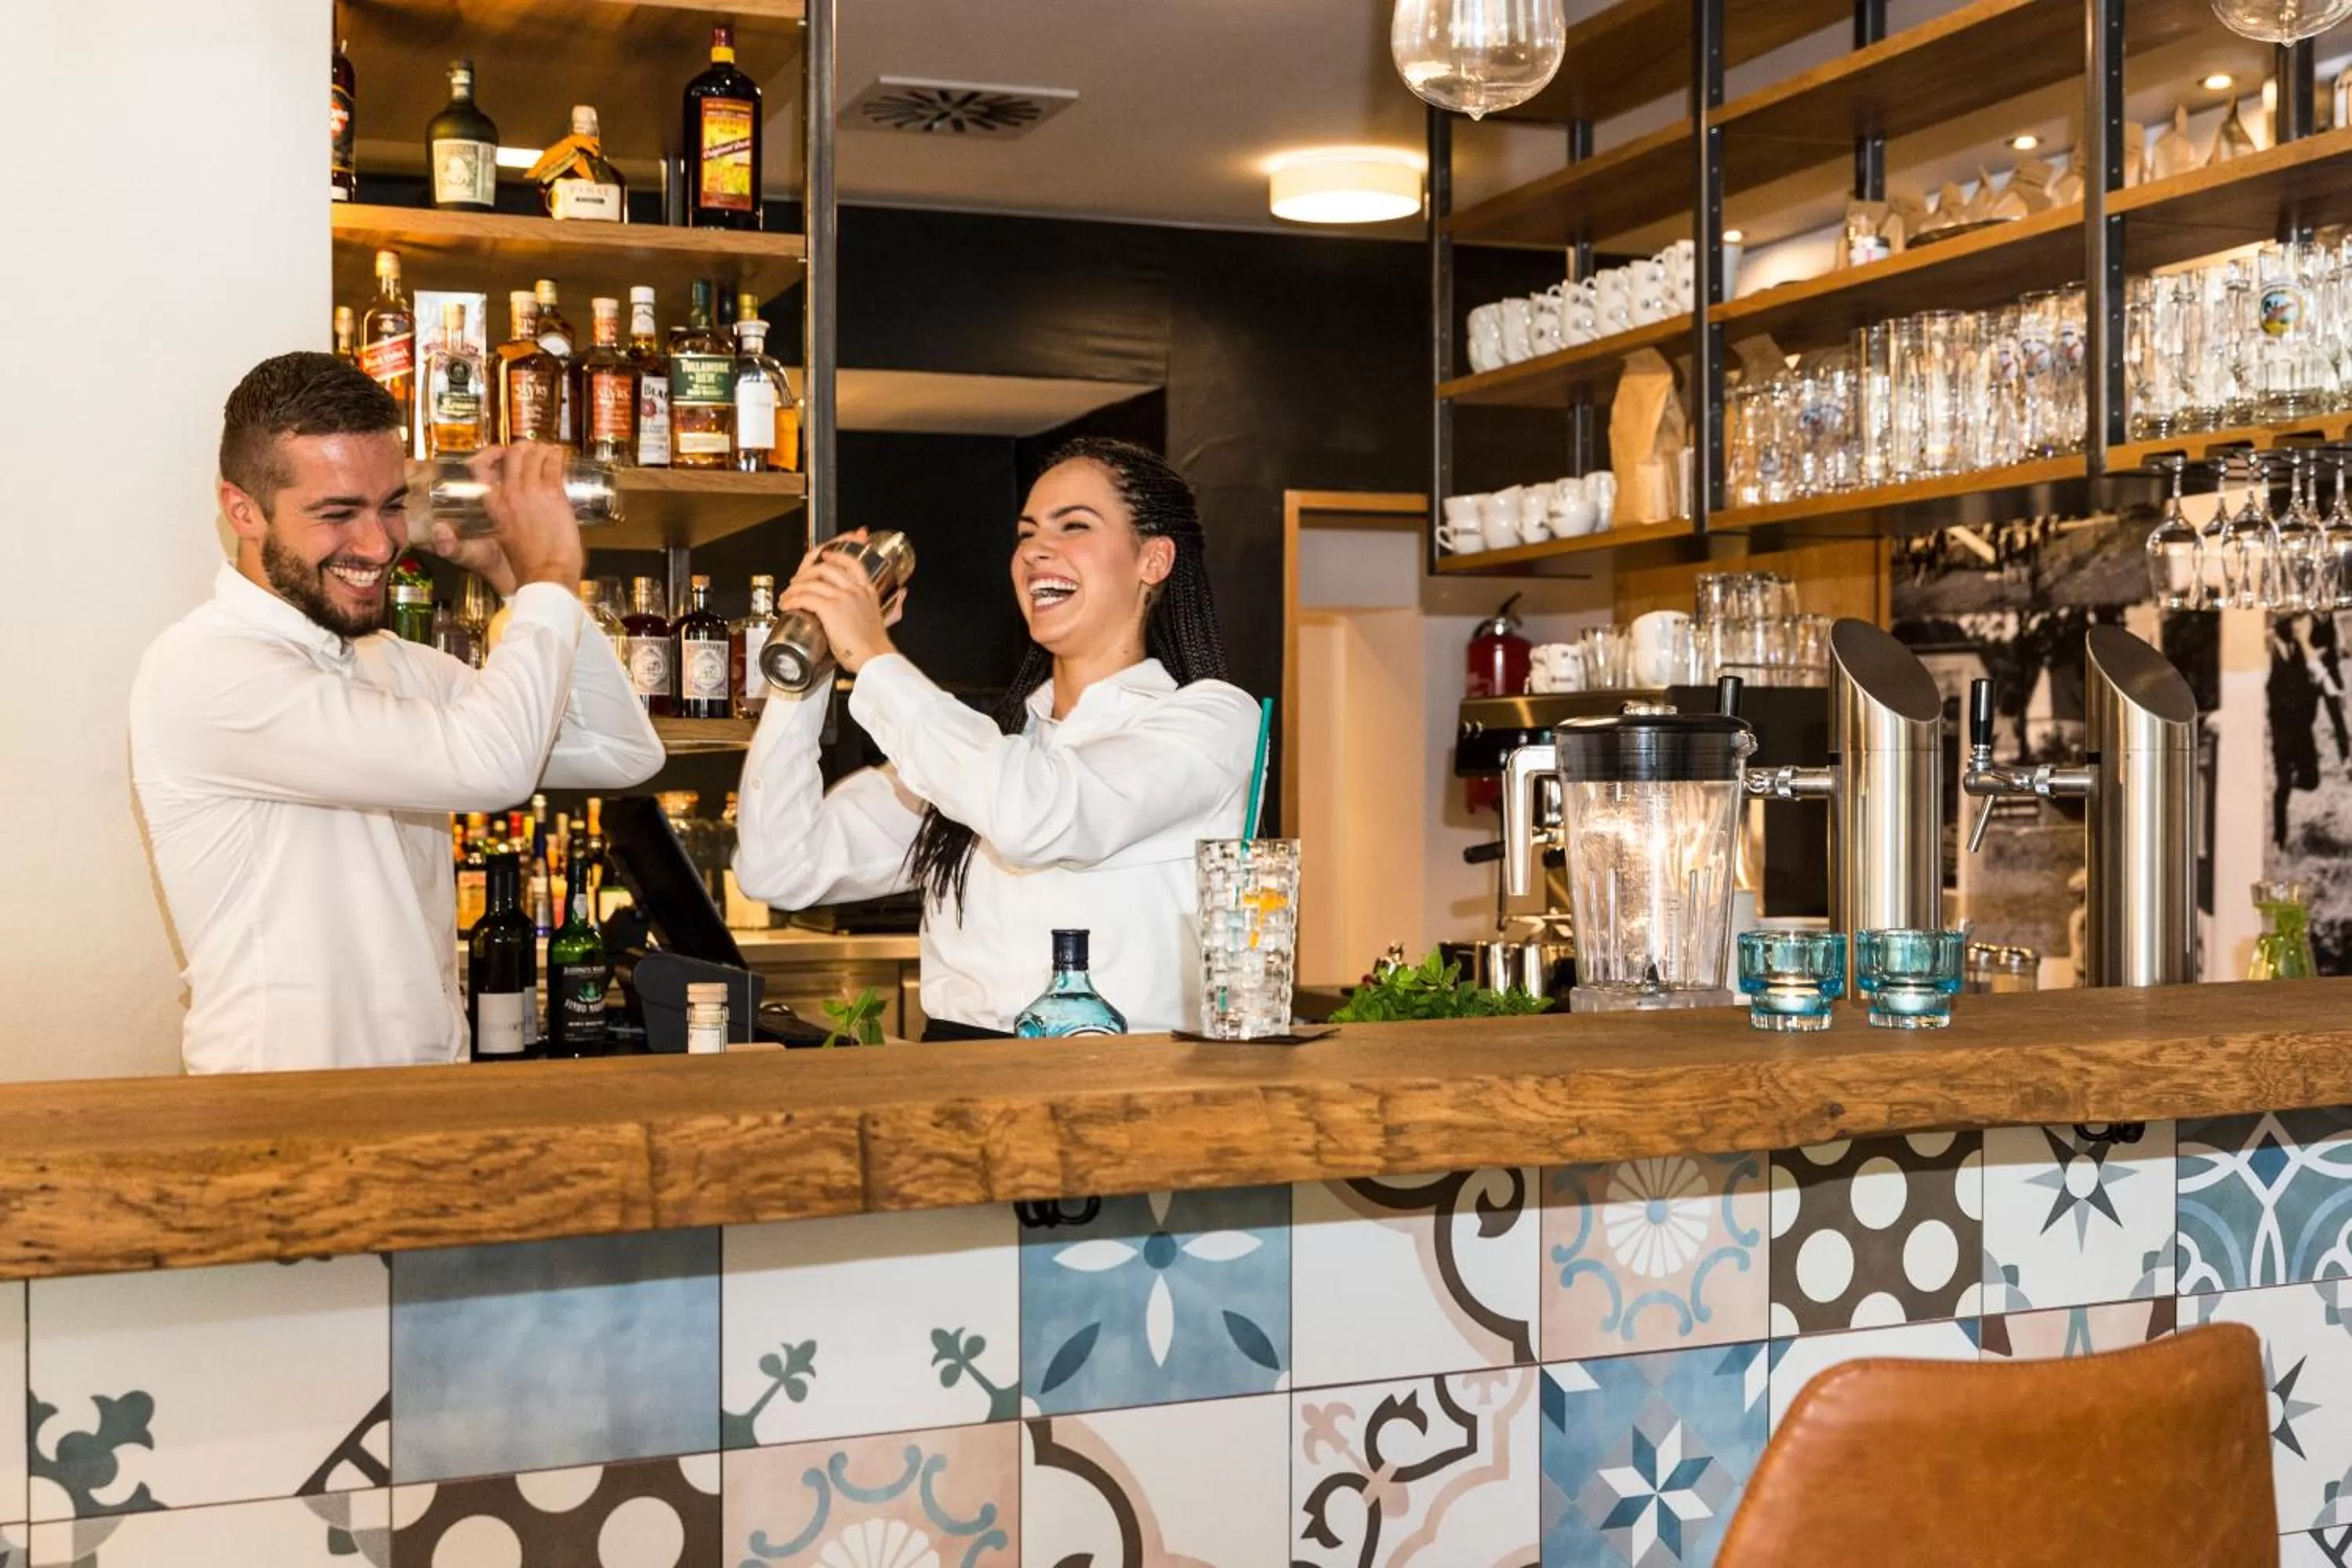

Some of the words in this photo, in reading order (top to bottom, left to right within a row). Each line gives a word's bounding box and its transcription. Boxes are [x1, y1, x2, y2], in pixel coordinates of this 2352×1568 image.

[679, 359, 729, 373] TULLAMORE
[514, 383, 548, 401] SLYRS
[598, 387, 628, 404] SLYRS
